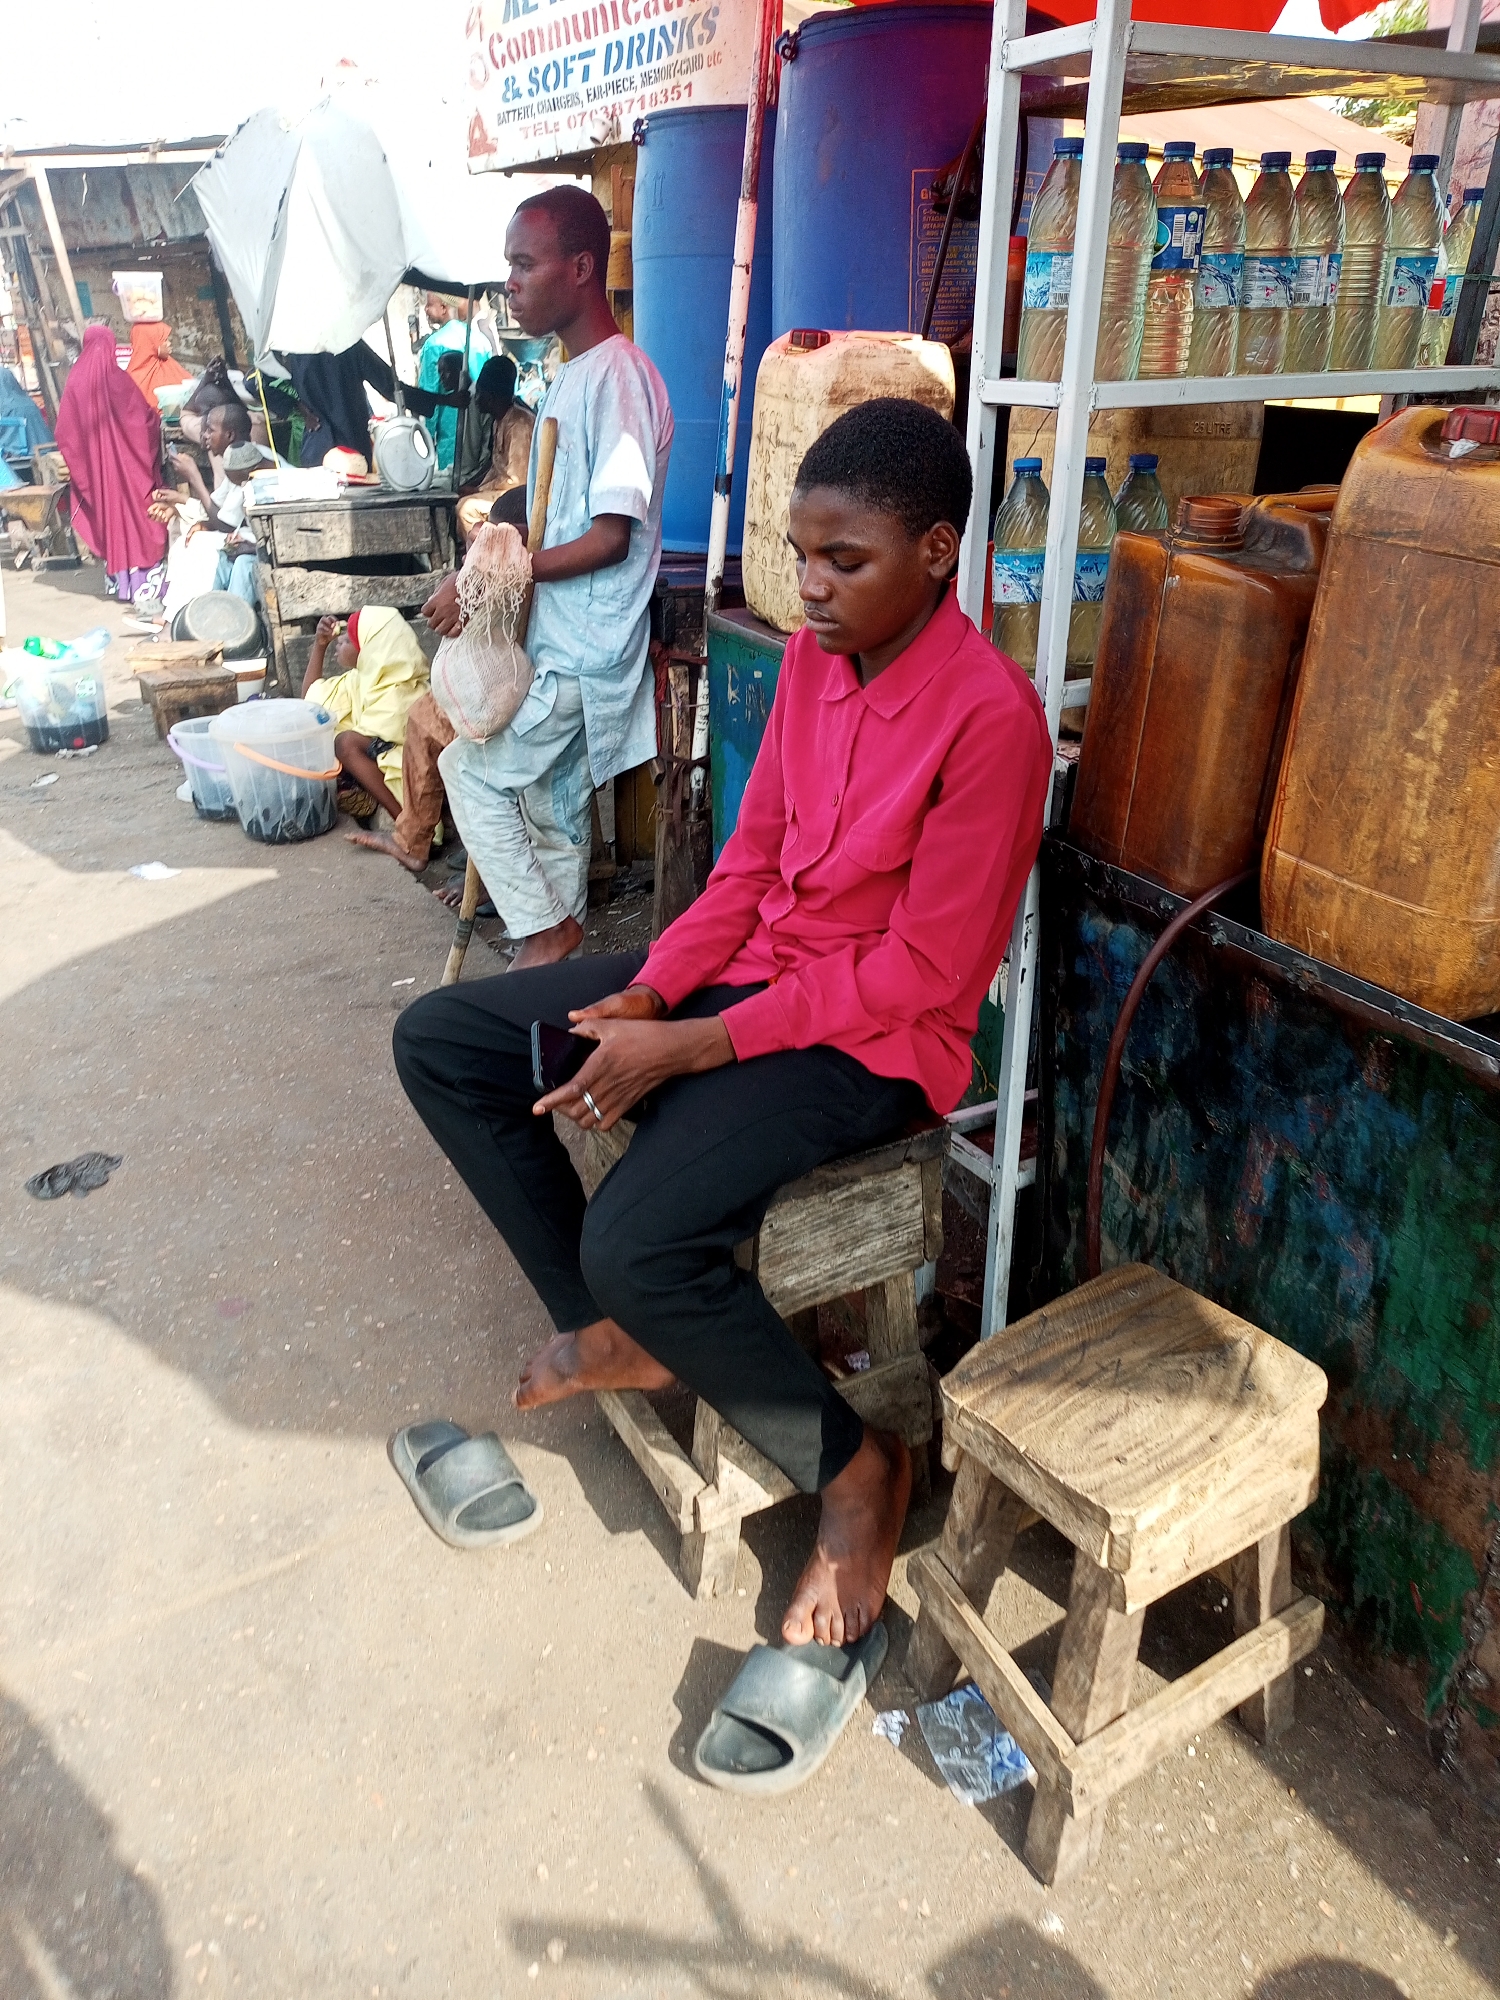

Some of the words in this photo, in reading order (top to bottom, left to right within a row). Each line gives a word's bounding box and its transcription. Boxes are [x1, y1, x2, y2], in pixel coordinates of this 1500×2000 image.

[488, 0, 698, 70] Communica
[502, 75, 522, 103] &
[528, 47, 596, 98] SOFT
[603, 6, 720, 76] DRINKS
[496, 103, 536, 126] BATTERY,
[537, 91, 583, 115] CHARGERS,
[586, 75, 638, 103] EAR-PIECE,
[640, 53, 704, 88] MEMORY-CARD
[706, 50, 723, 68] etc
[1206, 421, 1232, 435] LITRE
